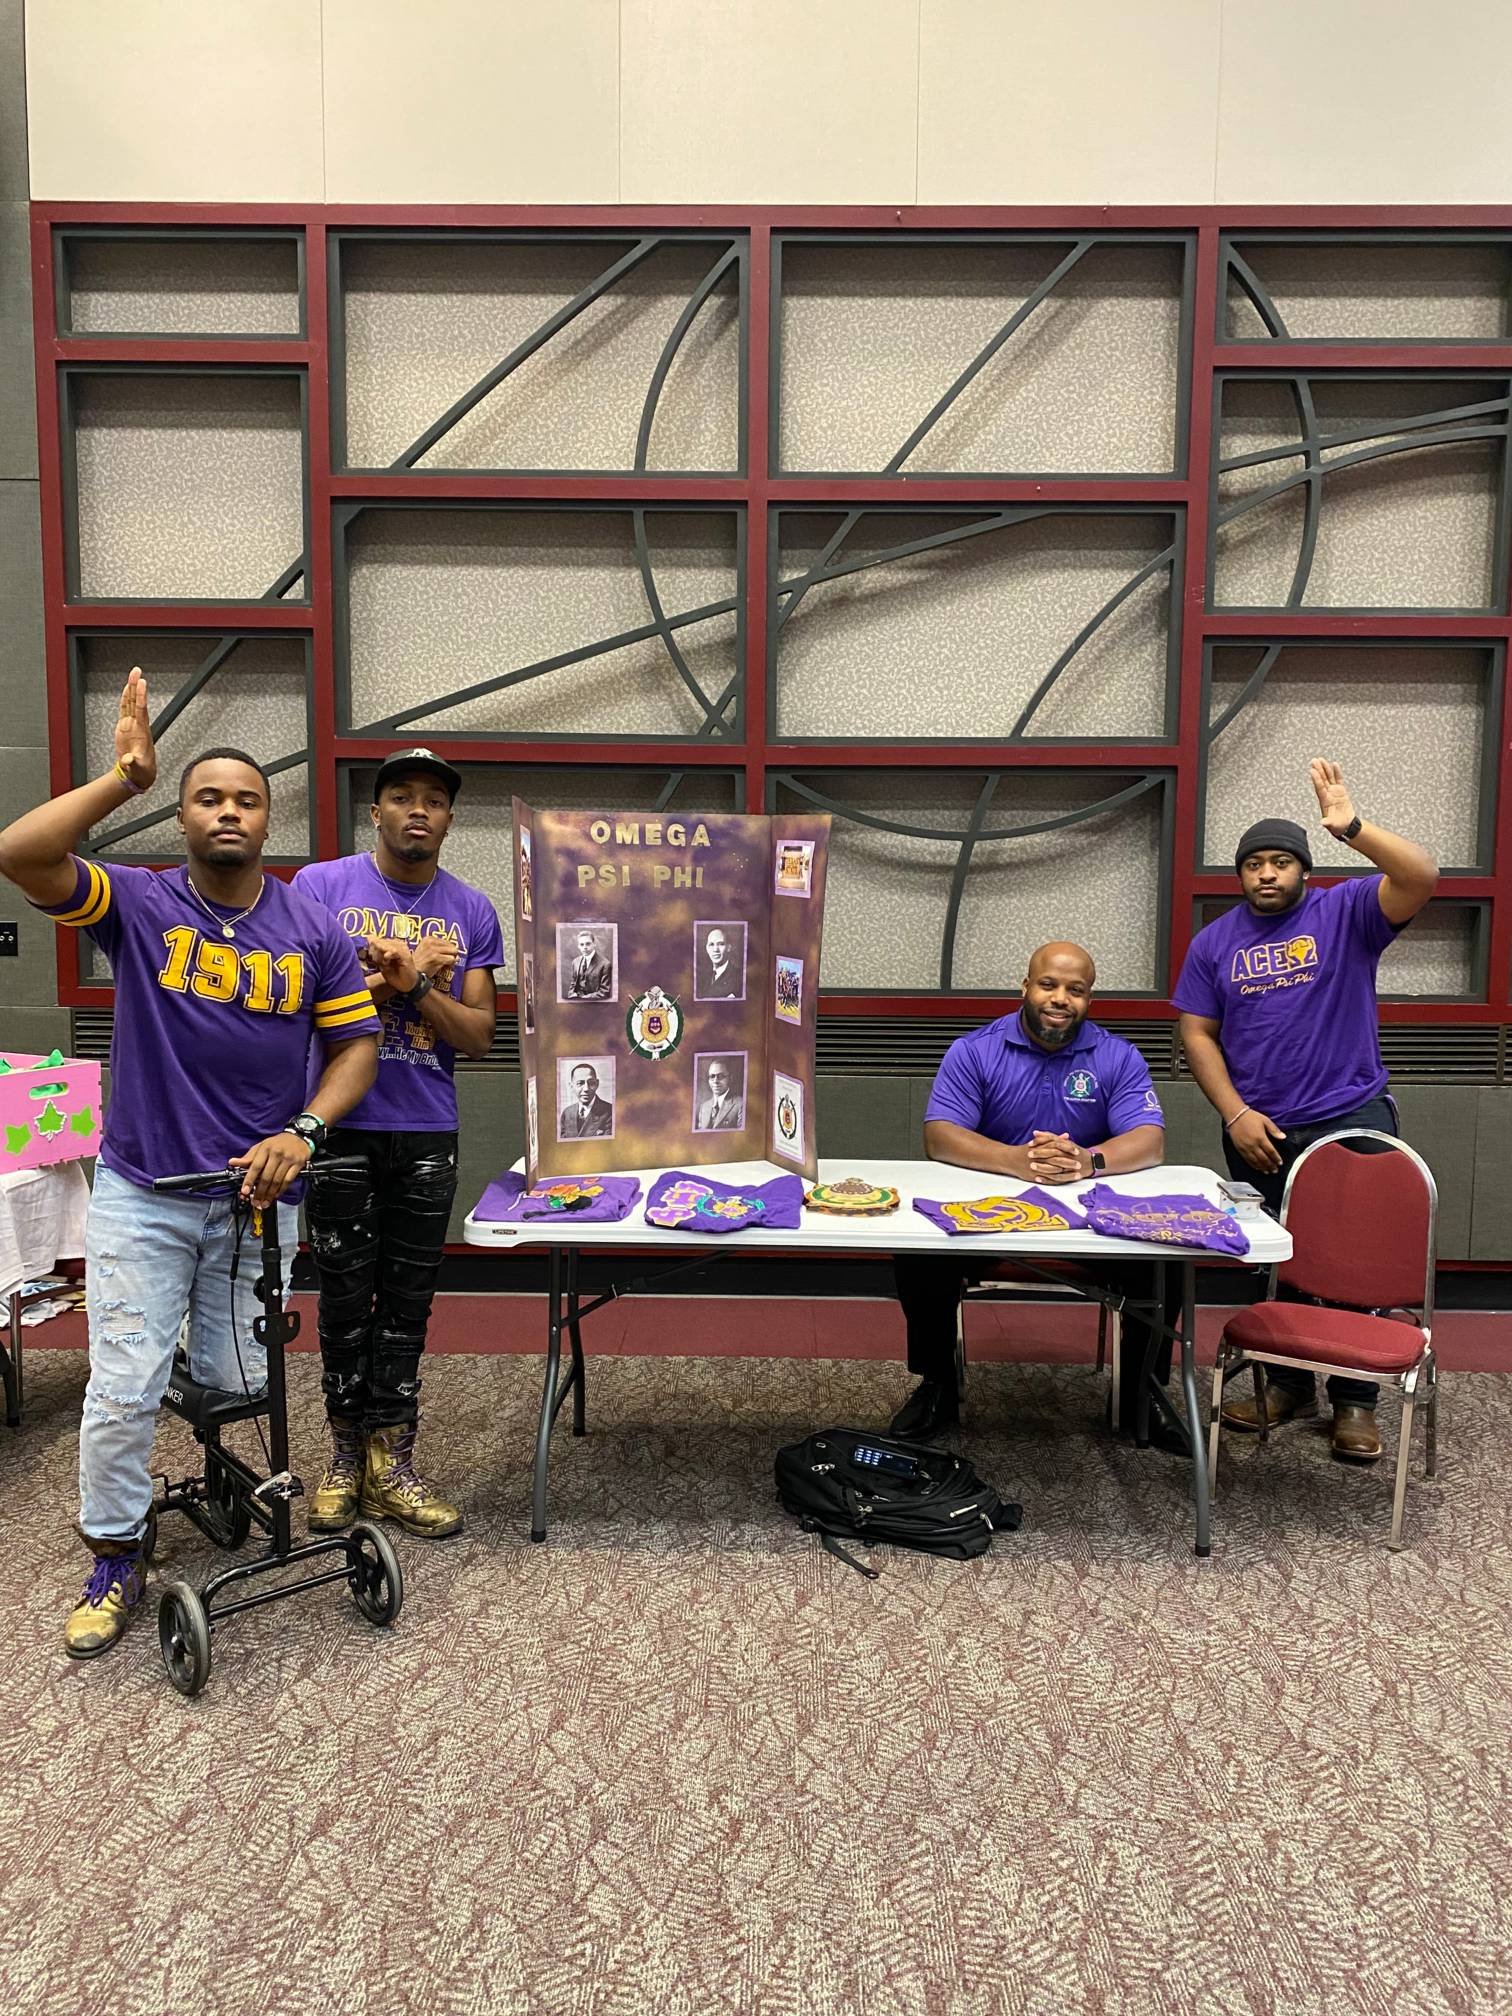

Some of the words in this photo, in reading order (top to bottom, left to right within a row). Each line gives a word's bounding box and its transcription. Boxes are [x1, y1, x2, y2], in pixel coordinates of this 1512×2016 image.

[590, 820, 711, 847] OMEGA
[577, 864, 631, 888] PSI
[653, 865, 704, 888] PHI
[158, 924, 305, 1015] 1911
[1240, 983, 1275, 996] Omega
[1274, 976, 1294, 989] Psi
[1294, 970, 1315, 986] Phi
